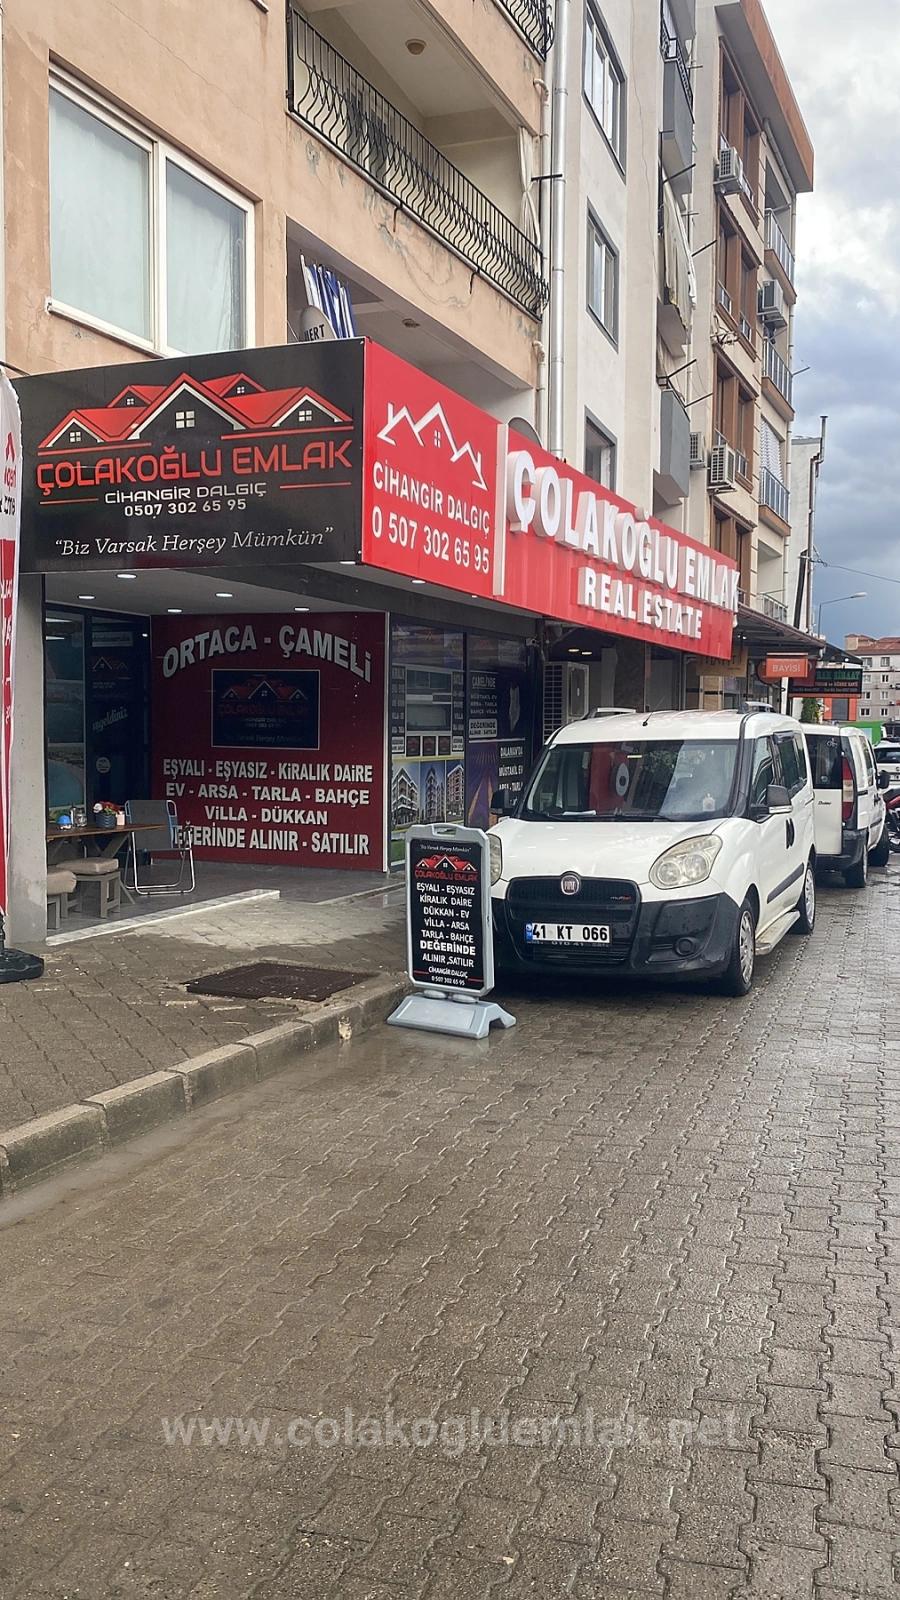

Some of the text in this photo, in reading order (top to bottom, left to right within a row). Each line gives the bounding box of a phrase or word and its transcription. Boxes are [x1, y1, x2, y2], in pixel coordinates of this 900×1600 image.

[37, 445, 222, 495] ÇOLAKOĞLU
[232, 439, 353, 475] EMLAK
[196, 482, 267, 498] DALGIÇ
[124, 499, 247, 518] 0507 302 65 95
[447, 494, 490, 539] DALGIÇ
[372, 505, 490, 576] 0 507 302 65 95
[508, 450, 740, 614] ÇOLAKOĞLU EMLAK
[95, 536, 157, 554] Varsak
[162, 532, 226, 554] Herşey
[578, 567, 703, 640] REAL ESTATE
[163, 625, 257, 678] ORTACA
[163, 759, 205, 778] EŞYALI
[216, 760, 267, 782] EŞYASIZ
[166, 783, 186, 797] EV
[198, 784, 238, 799] ARSA
[252, 786, 301, 802] TARLA
[315, 789, 370, 808] BAHÇE
[261, 806, 328, 825] DÜKKAN
[249, 831, 298, 851] ALINIR
[312, 832, 370, 856] SATILIR
[416, 882, 440, 895] EŞYALI
[446, 884, 475, 896] EŞYASIZ
[423, 905, 454, 917] DÜKKAN
[460, 910, 470, 919] EV
[451, 921, 470, 931] ARSA
[532, 924, 607, 941] 41 KT 066
[421, 929, 444, 940] TARLA
[450, 932, 474, 945] BAHÇE
[420, 939, 476, 956] DEĞERİNDE
[422, 952, 446, 964] ALINIR
